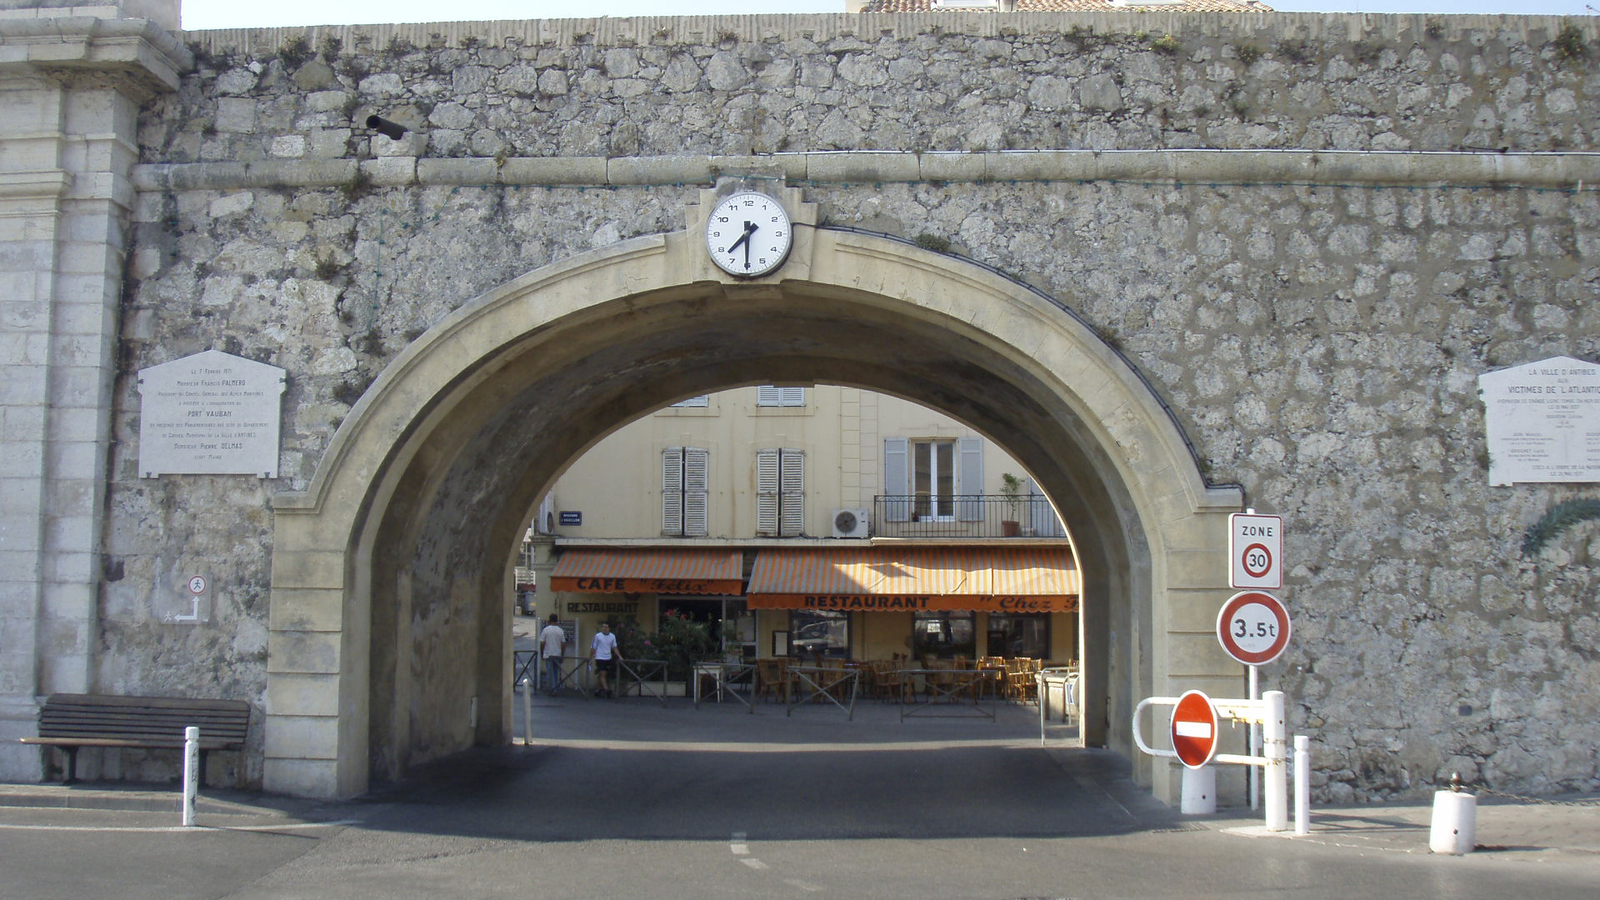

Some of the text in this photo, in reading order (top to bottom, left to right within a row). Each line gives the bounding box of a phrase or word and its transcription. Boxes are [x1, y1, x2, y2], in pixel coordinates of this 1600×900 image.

[1529, 368, 1537, 376] LA
[1541, 368, 1558, 376] VILLE
[1508, 386, 1543, 394] VICTIMES
[1546, 386, 1556, 394] DE
[1242, 525, 1273, 537] ZONE
[1249, 554, 1266, 568] 30
[577, 577, 625, 590] CAFE
[567, 602, 639, 613] RESTAURANT
[805, 596, 930, 608] RESTAURANT
[1234, 619, 1276, 638] 3.5t
